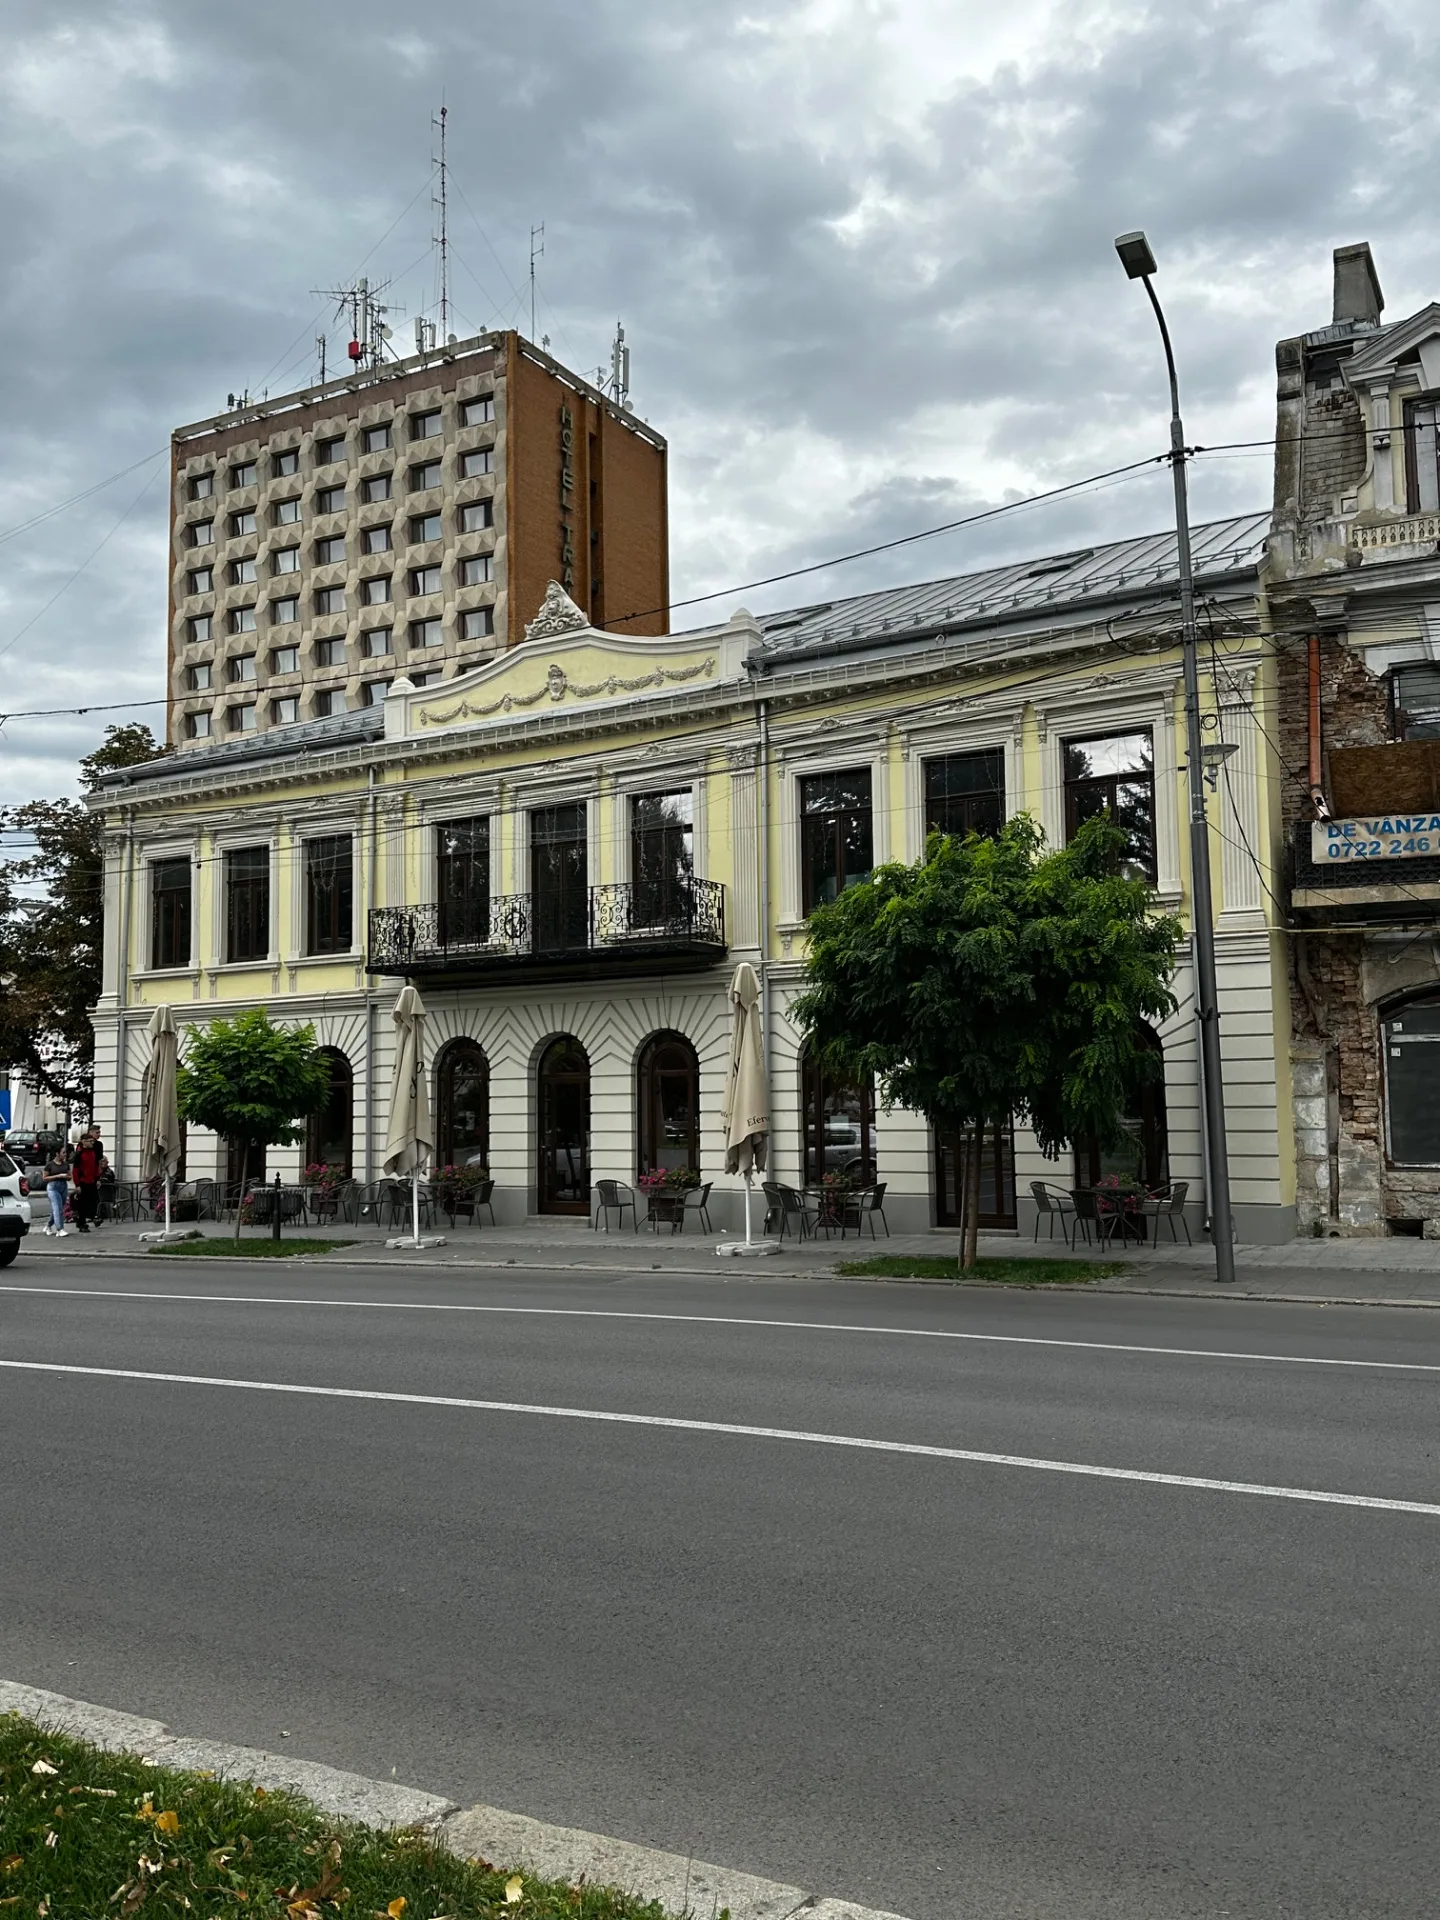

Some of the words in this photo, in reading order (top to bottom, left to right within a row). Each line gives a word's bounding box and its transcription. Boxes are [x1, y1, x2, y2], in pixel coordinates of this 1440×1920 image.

[562, 405, 574, 512] HOTEL
[1328, 823, 1357, 838] DE
[1328, 840, 1382, 858] 0722
[1389, 837, 1431, 854] 246
